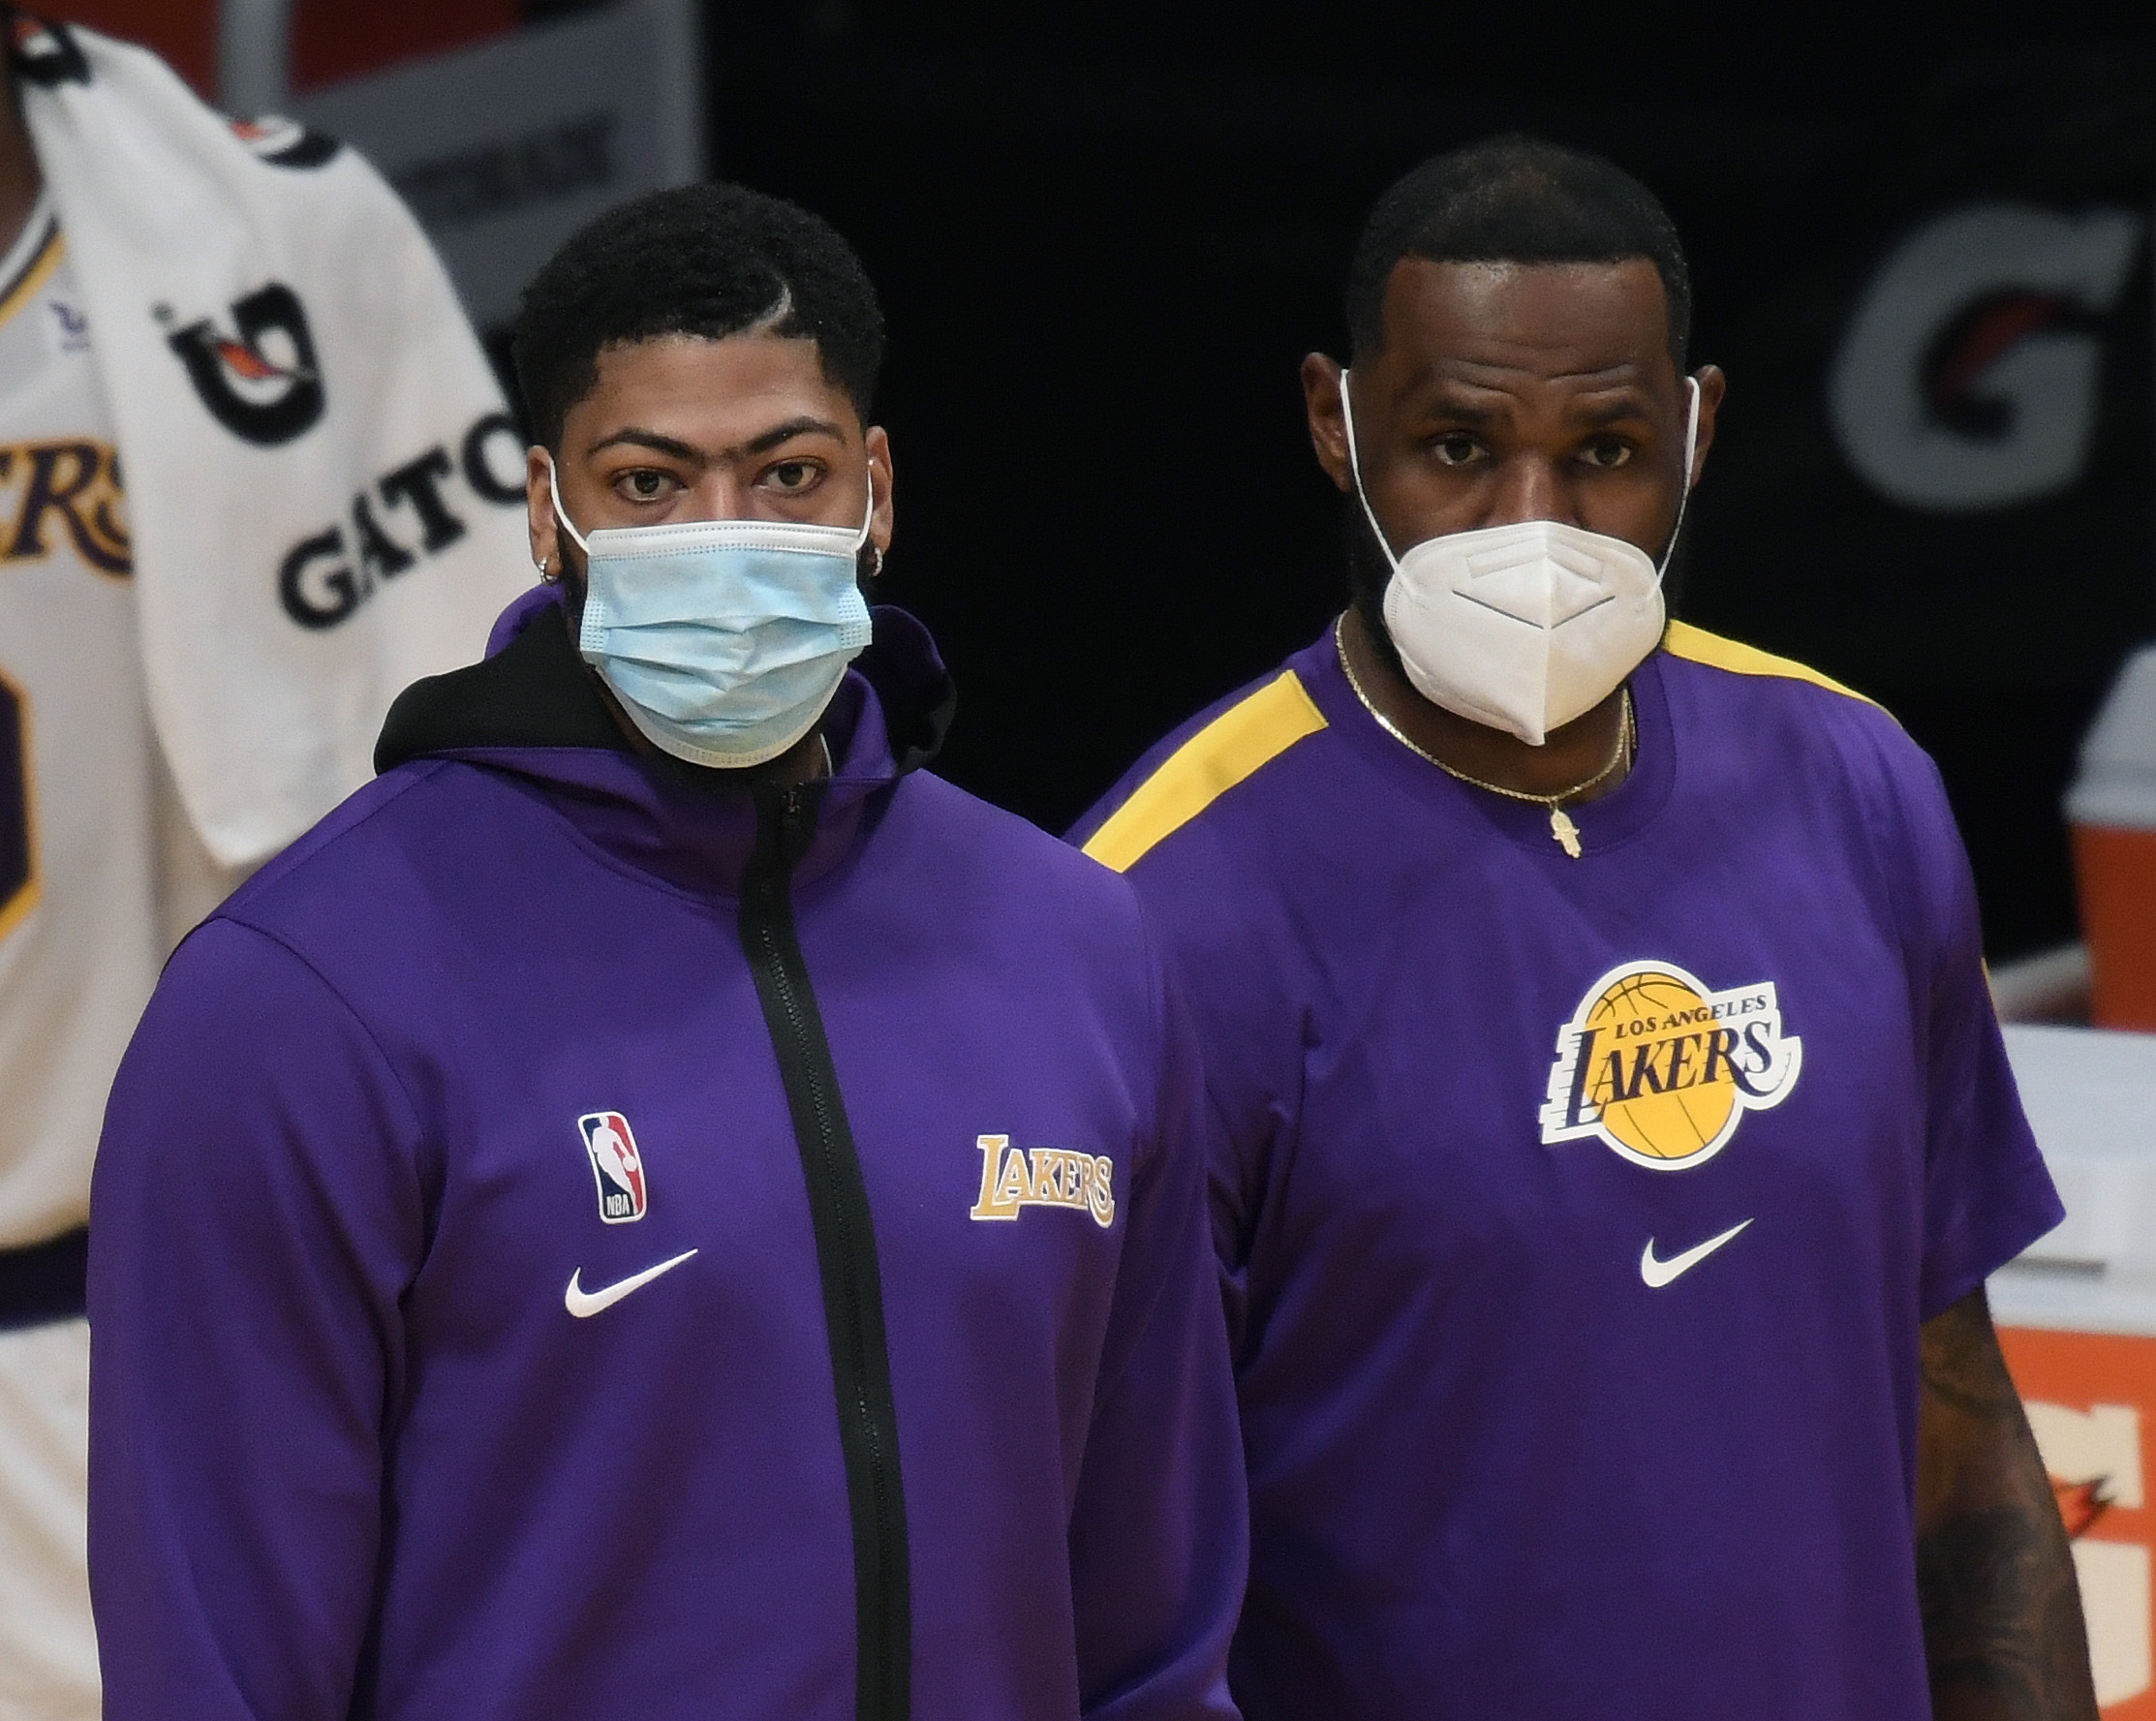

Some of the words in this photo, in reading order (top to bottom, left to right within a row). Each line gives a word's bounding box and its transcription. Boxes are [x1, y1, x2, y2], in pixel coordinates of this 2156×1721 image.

[1615, 1016, 1657, 1039] LOS
[1661, 995, 1767, 1030] ANGELES
[1555, 1021, 1792, 1131] LAKERS
[606, 1194, 630, 1215] NBA
[970, 1134, 1115, 1228] LAKERS
